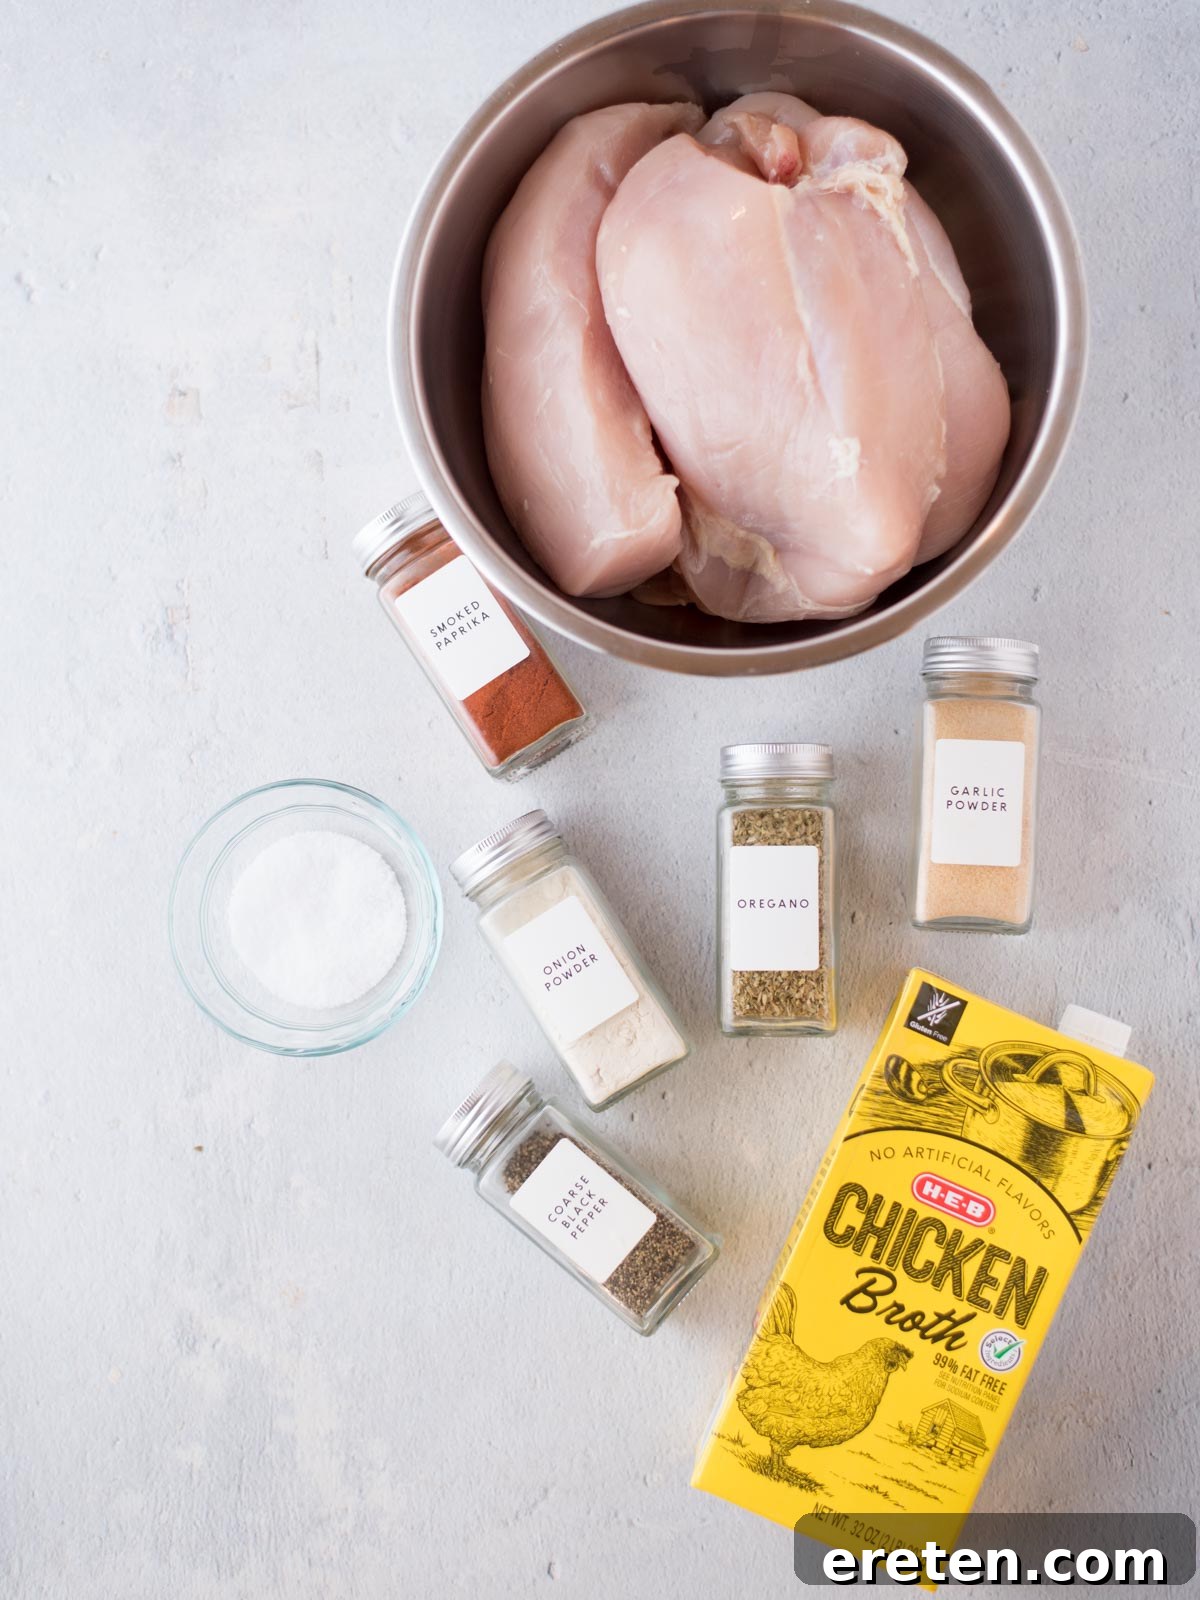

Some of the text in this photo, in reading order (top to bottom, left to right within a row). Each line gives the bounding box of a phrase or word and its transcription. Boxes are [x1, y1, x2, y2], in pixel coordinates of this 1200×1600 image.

[430, 601, 480, 638] SMOKED
[435, 612, 490, 650] PAPRIKA
[946, 800, 1007, 812] POWDER
[950, 785, 1005, 797] GARLIC
[737, 898, 809, 909] OREGANO
[543, 944, 586, 975] ONION
[544, 953, 599, 992] POWDER
[909, 1020, 948, 1042] Gluten Free
[547, 1175, 590, 1223] COARSE
[561, 1189, 597, 1229] BLACK
[869, 1146, 1056, 1240] NO ARTIFICIAL FLAVORS
[570, 1197, 609, 1240] PEPPER
[823, 1182, 1049, 1330] CHICKEN
[839, 1265, 978, 1351] Broth
[985, 1335, 1012, 1348] Select
[932, 1352, 1008, 1396] 99% FAT FREE
[811, 1502, 833, 1523] NET
[831, 1509, 850, 1532] WT.
[850, 1520, 865, 1538] 32
[863, 1526, 881, 1545] OZ
